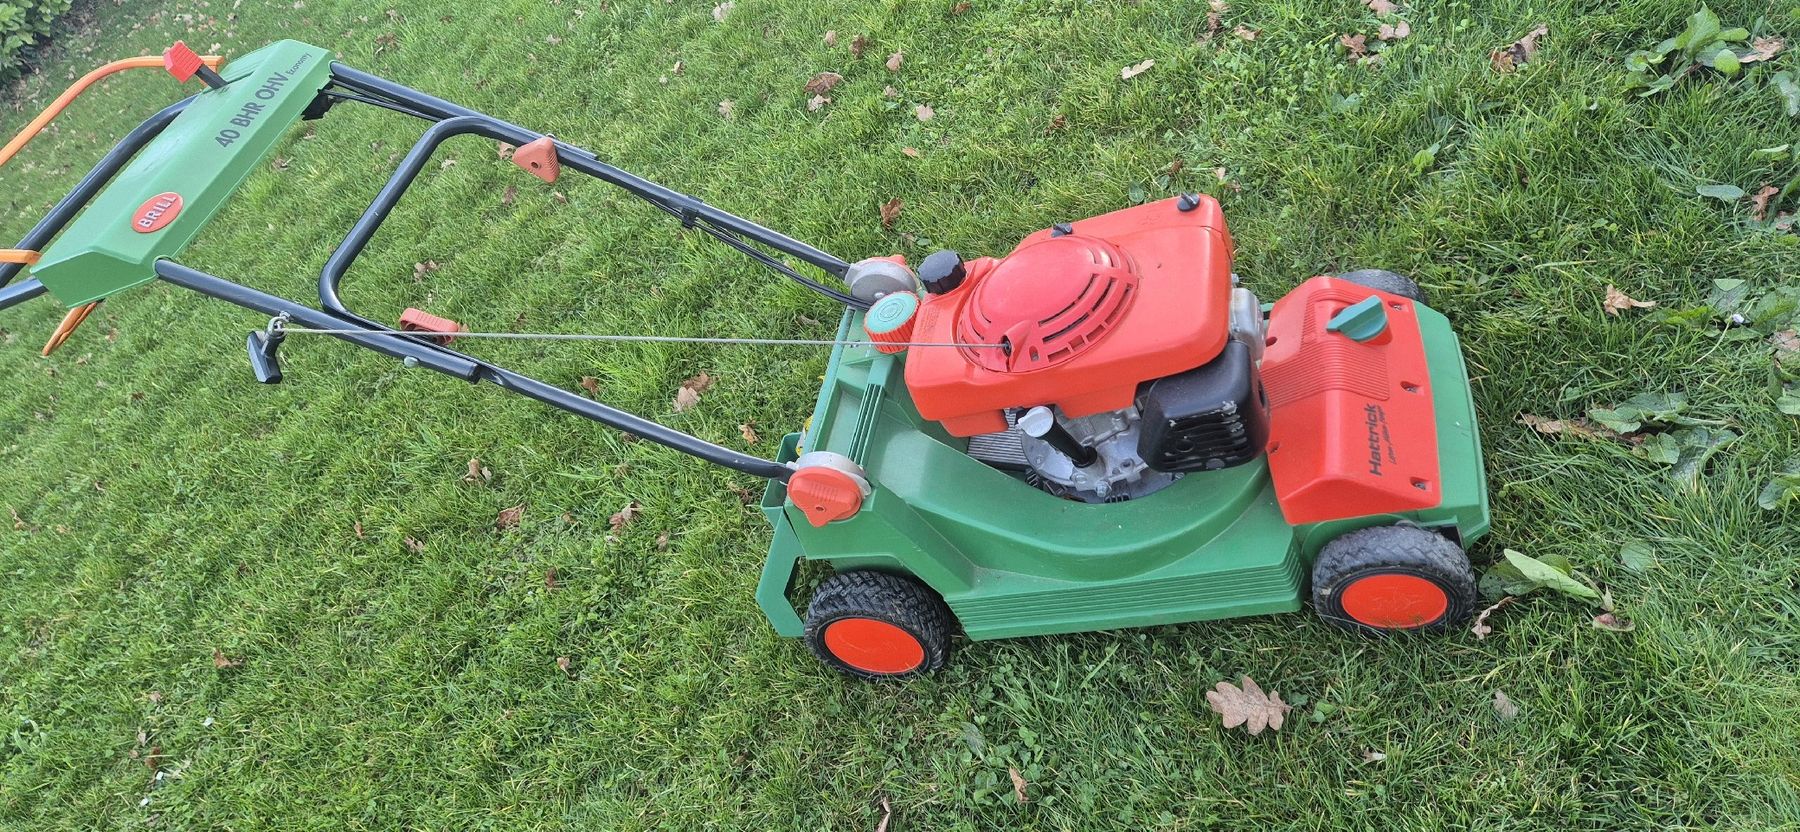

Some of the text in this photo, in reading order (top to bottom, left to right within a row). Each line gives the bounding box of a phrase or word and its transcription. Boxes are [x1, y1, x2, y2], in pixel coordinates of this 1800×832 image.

[215, 129, 241, 148] 40
[230, 102, 266, 128] BHR
[255, 72, 289, 100] OHV
[138, 196, 177, 228] BRILL
[1364, 403, 1382, 476] Hattrick
